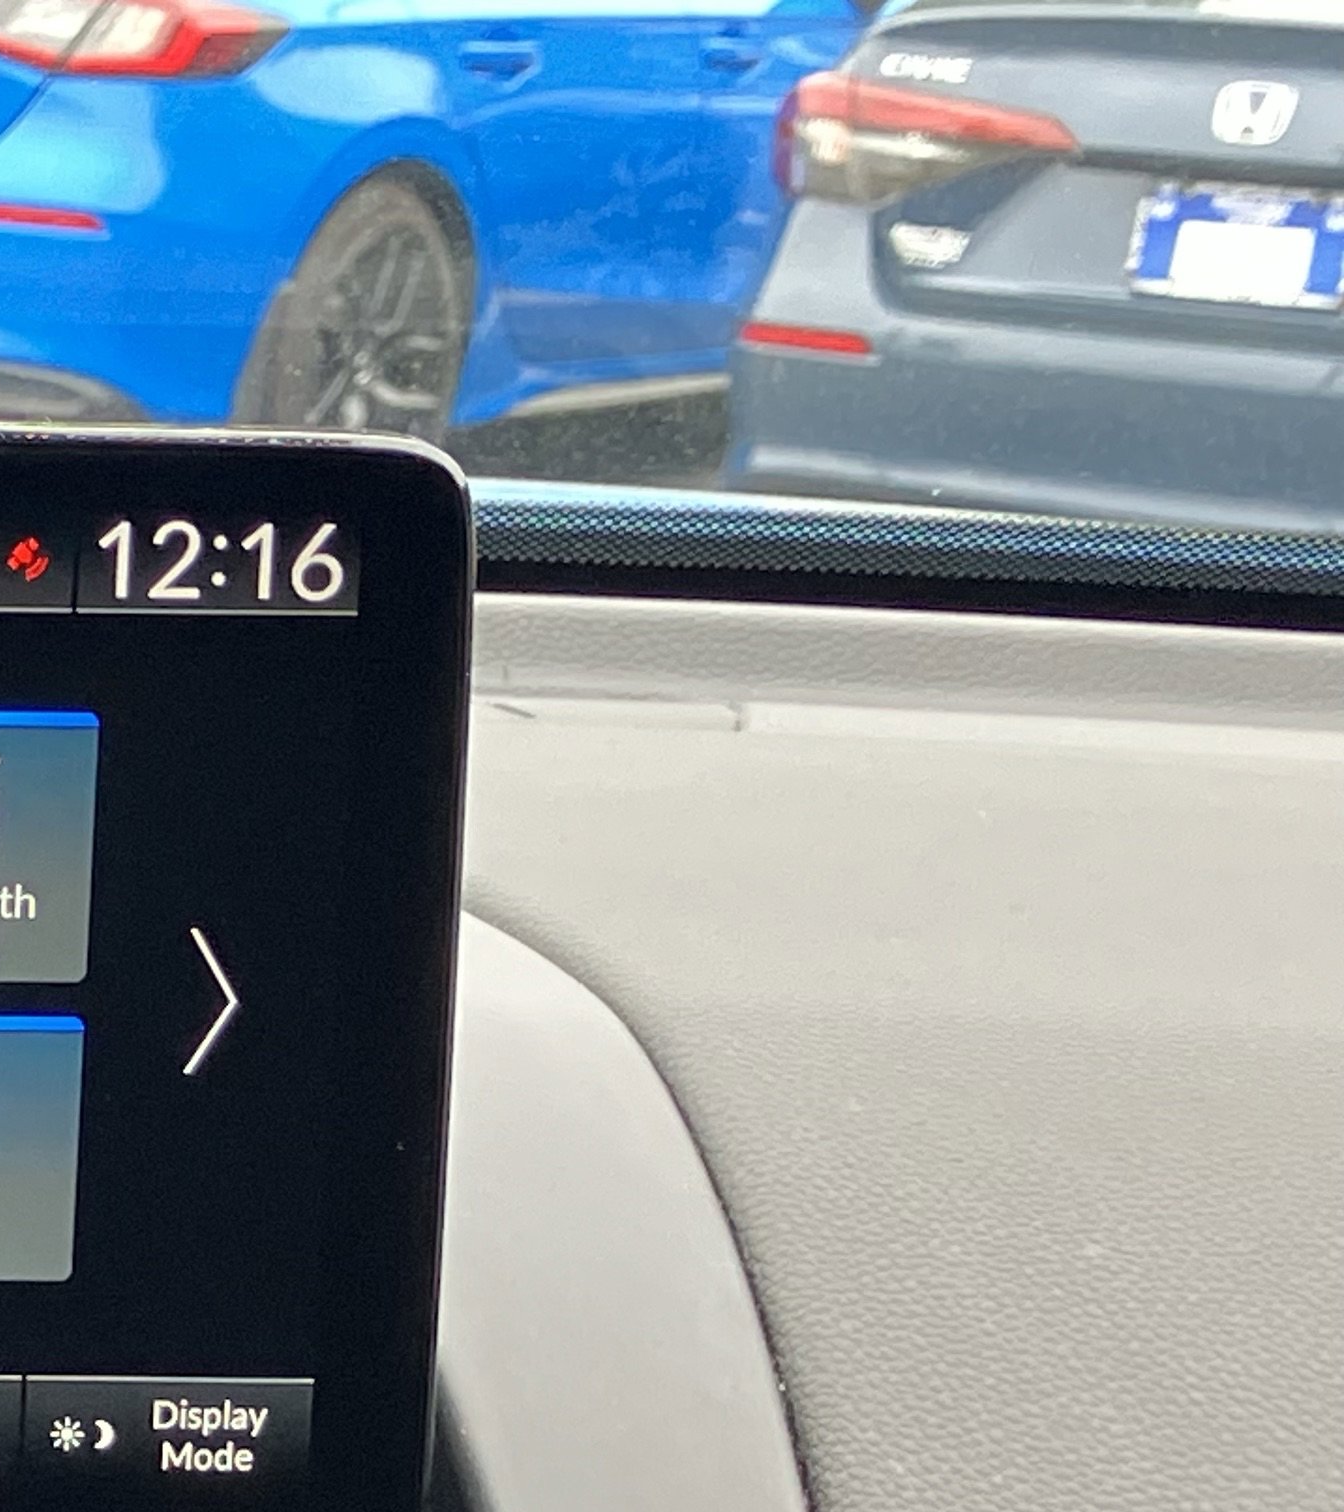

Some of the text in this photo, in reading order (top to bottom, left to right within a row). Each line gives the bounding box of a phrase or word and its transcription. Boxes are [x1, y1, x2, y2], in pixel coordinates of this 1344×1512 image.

[97, 517, 347, 602] 12:16
[148, 1398, 270, 1438] Display
[157, 1439, 256, 1474] Mode
